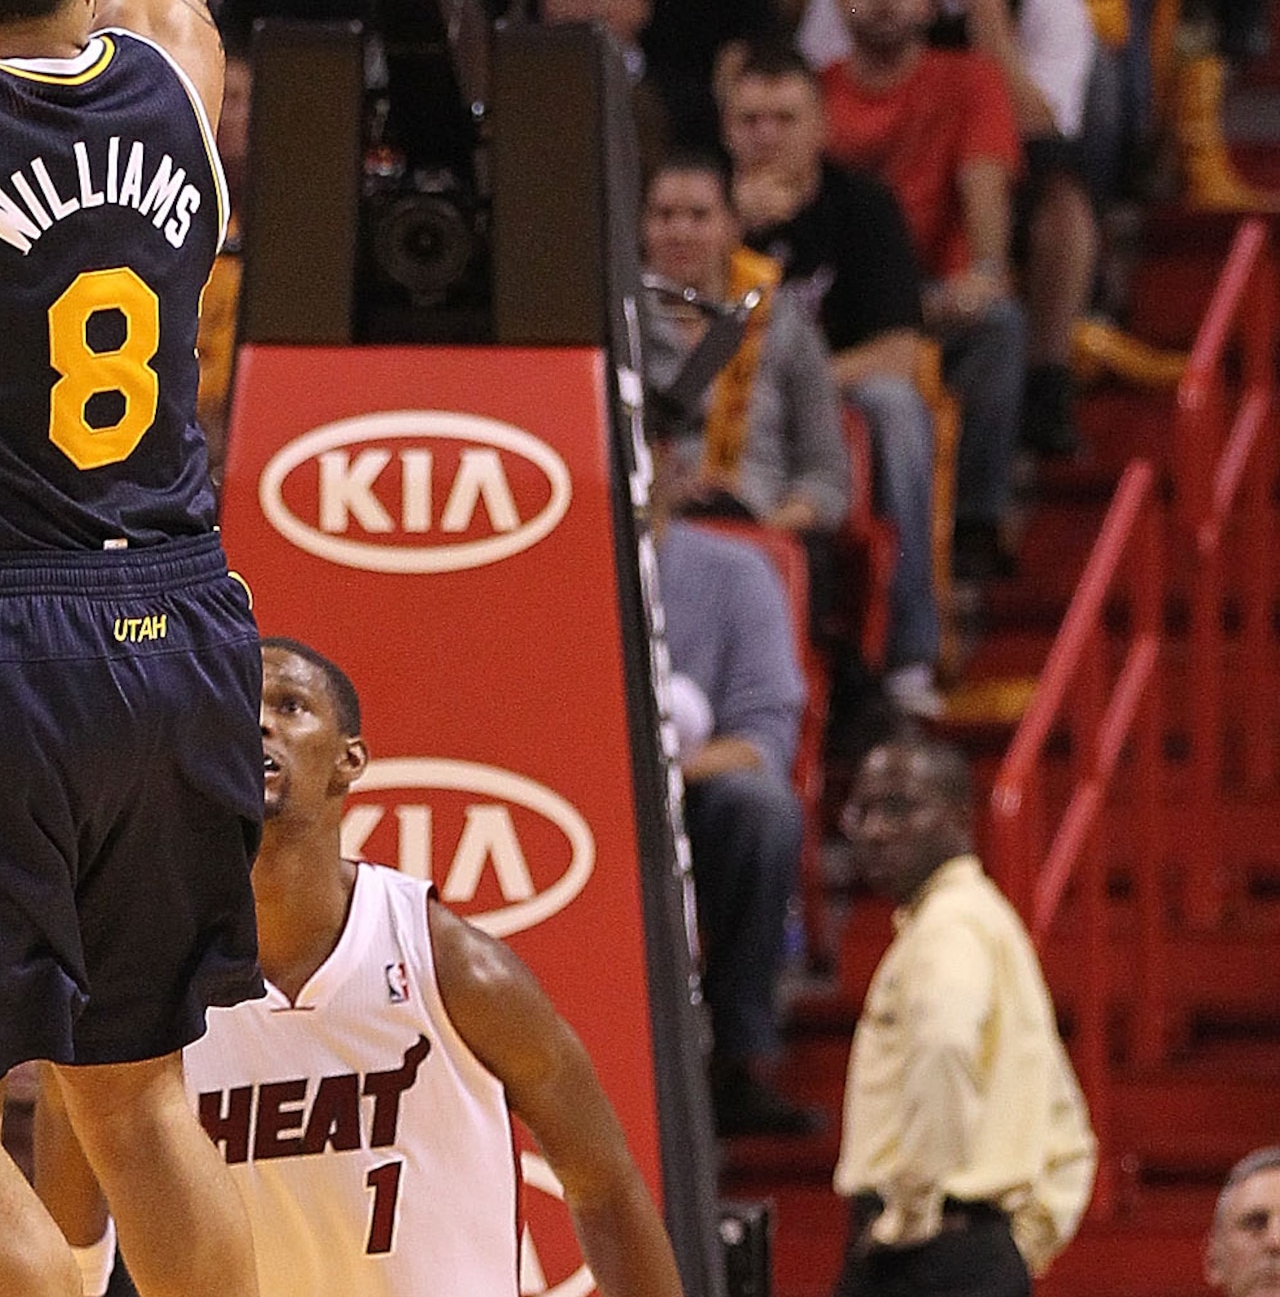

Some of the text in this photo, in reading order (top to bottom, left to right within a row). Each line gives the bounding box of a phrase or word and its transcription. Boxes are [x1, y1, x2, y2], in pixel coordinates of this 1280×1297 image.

[48, 266, 160, 471] 8
[317, 447, 521, 535] KIA
[113, 613, 168, 643] UTAH
[199, 1033, 431, 1165] HEAT
[364, 1160, 405, 1256] 1
